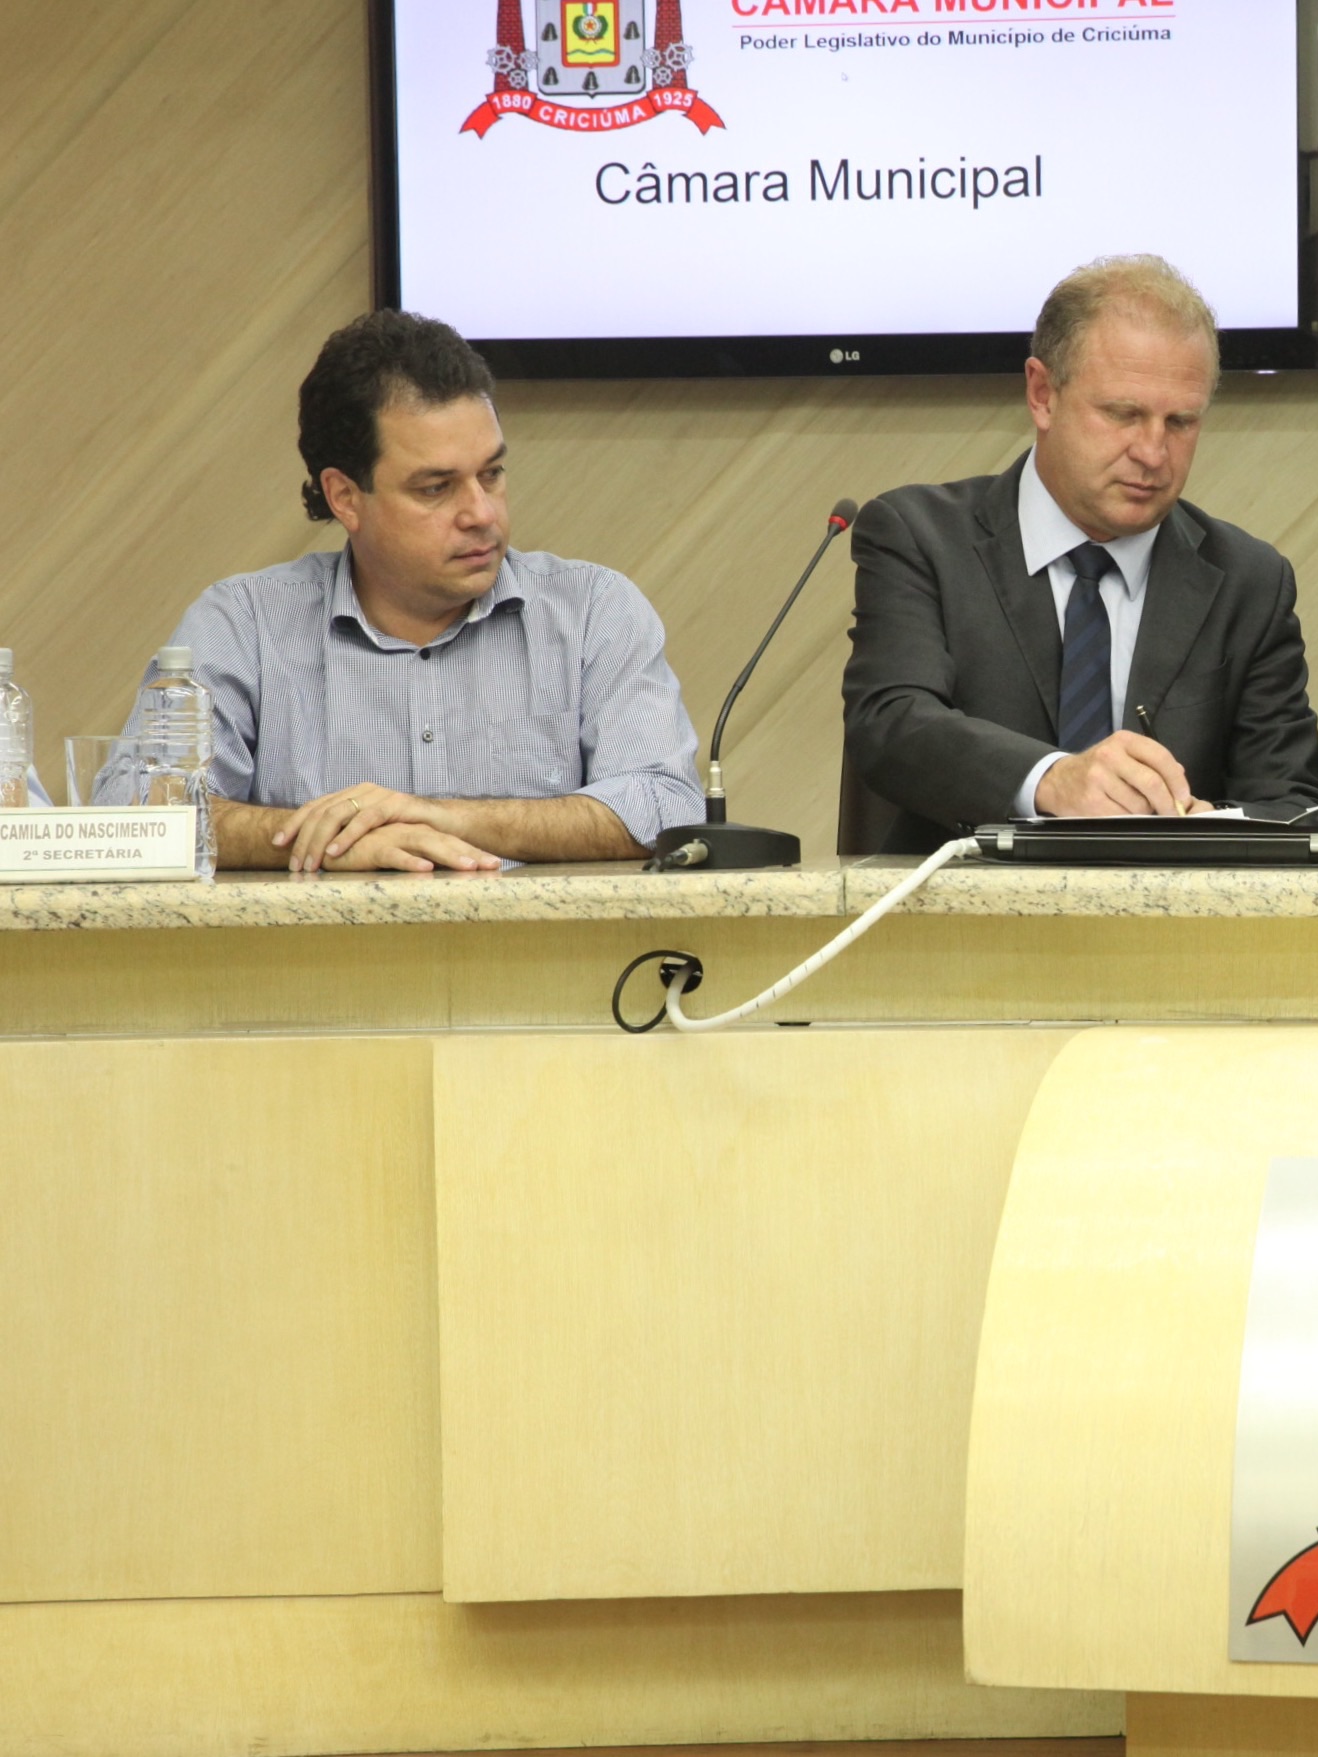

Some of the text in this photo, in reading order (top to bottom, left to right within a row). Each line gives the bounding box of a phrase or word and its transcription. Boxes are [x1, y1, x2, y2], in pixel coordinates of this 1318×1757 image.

[740, 24, 1172, 52] Poder Legislativo do Município de Criciúma
[492, 93, 533, 110] 1880
[653, 91, 694, 108] 1925
[538, 107, 647, 128] CRICIÚMA
[595, 154, 1043, 210] Câmara Municipal
[845, 350, 860, 361] LG
[0, 821, 167, 841] CAMILA DO NASCIMENTO
[43, 847, 143, 861] SECRETÁRIA
